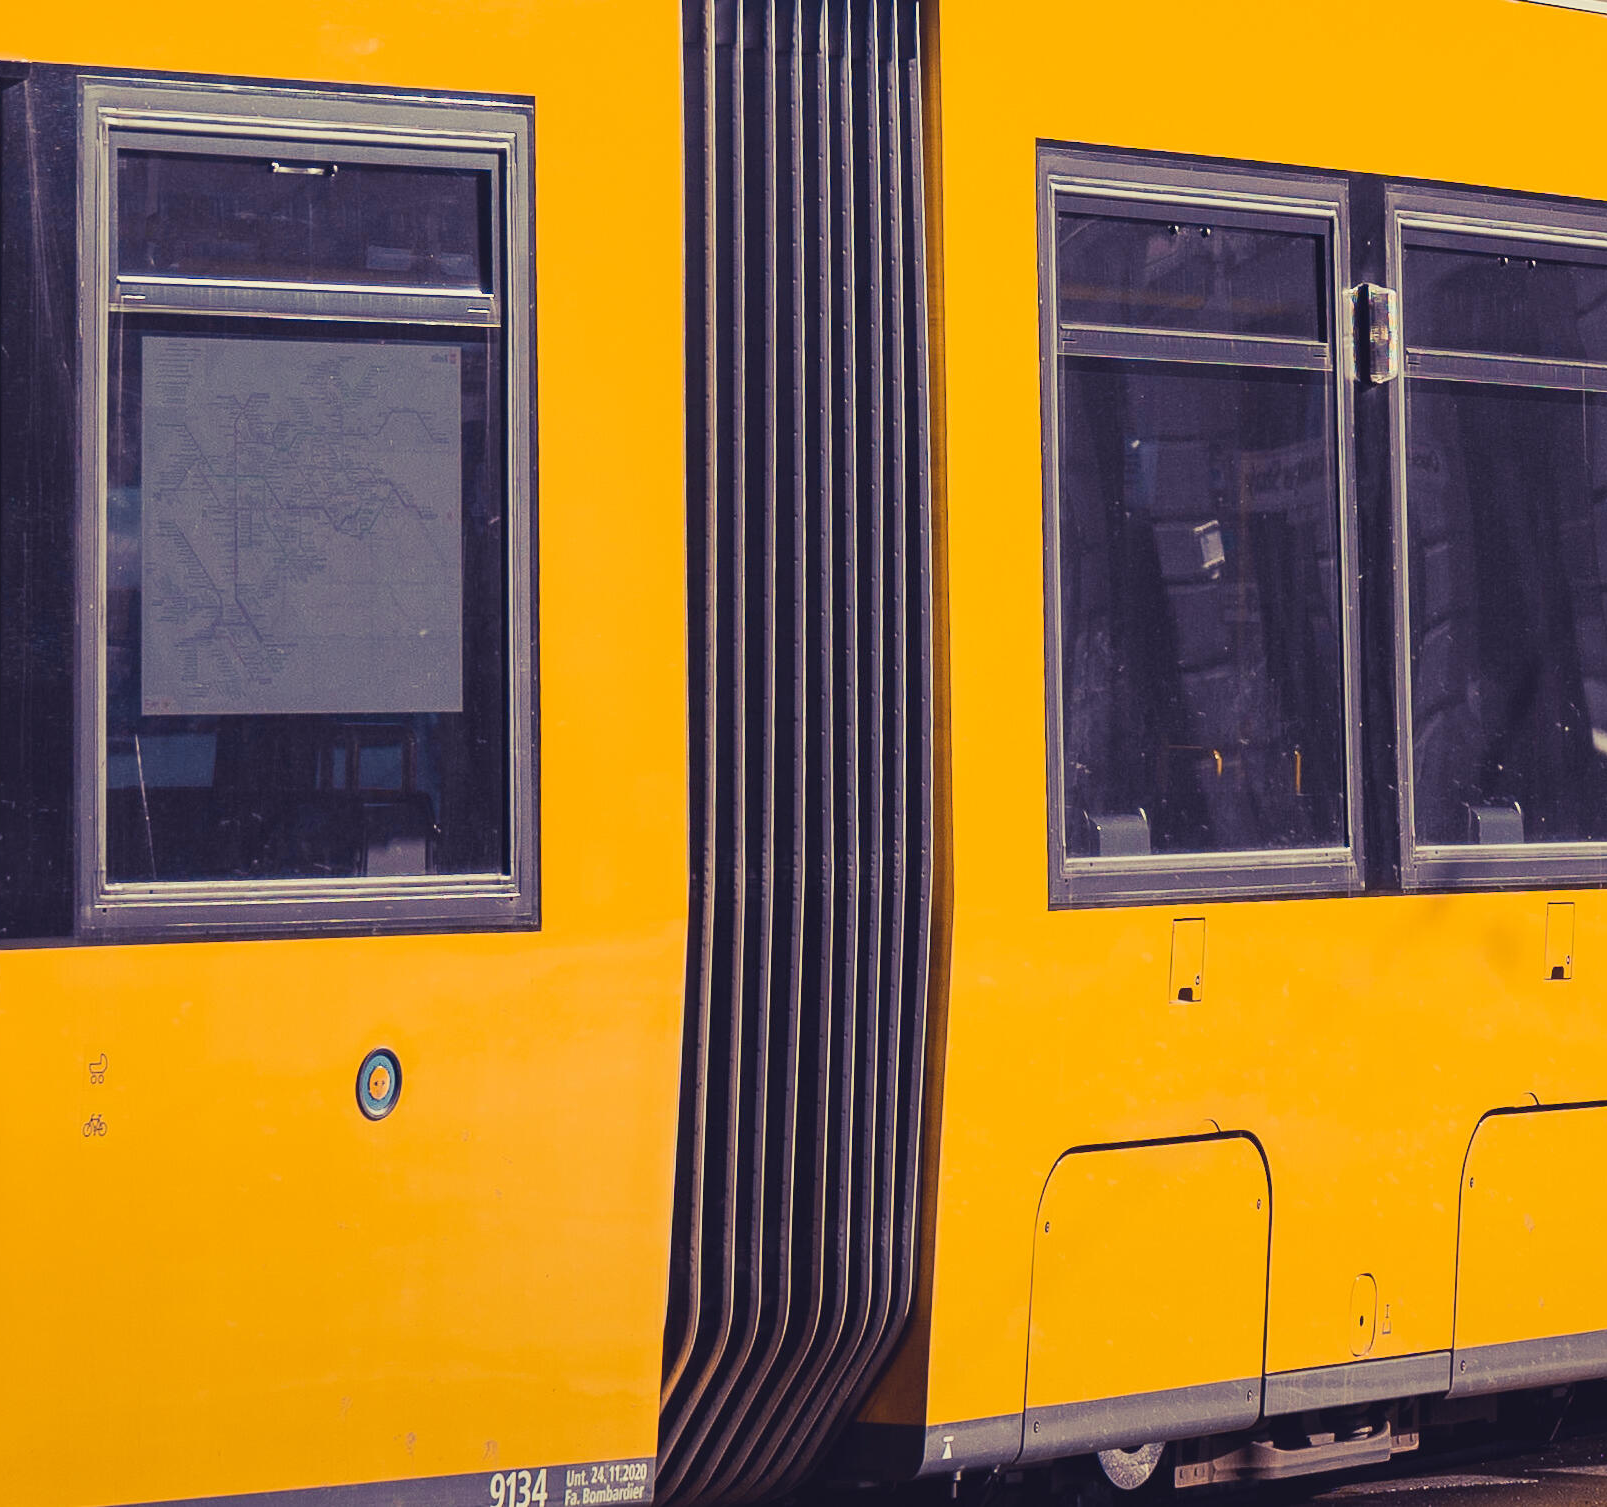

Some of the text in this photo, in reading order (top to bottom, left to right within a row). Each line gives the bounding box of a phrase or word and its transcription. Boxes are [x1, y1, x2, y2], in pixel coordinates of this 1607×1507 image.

[490, 1468, 548, 1507] 9134
[566, 1470, 589, 1487] Unt.
[564, 1484, 645, 1506] Fa. Bombardier
